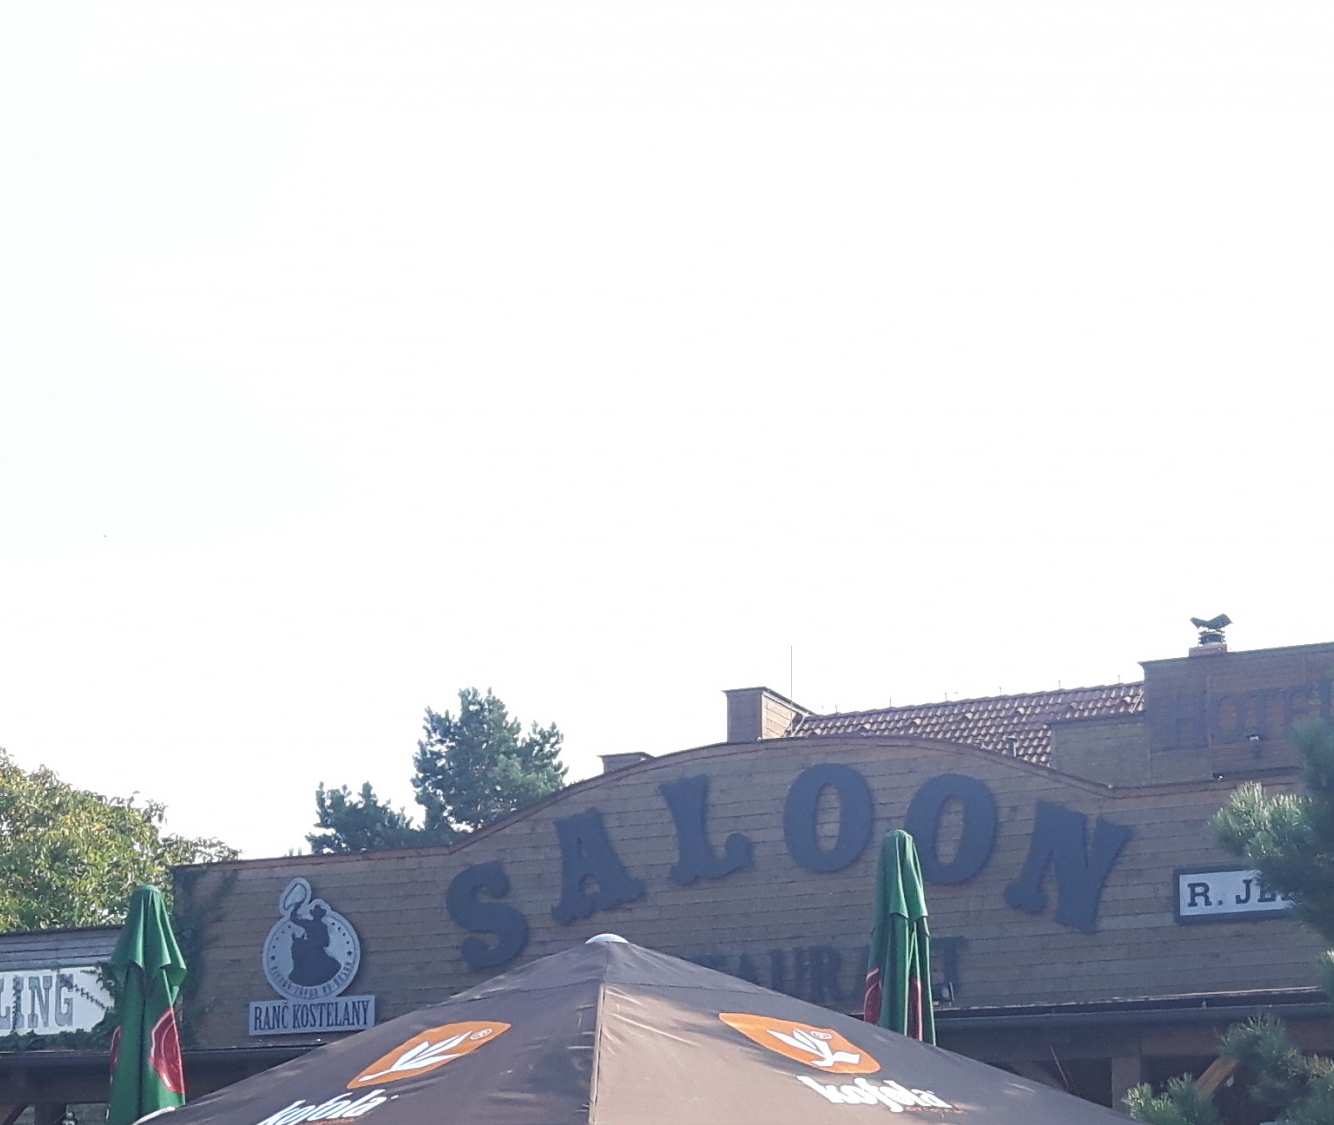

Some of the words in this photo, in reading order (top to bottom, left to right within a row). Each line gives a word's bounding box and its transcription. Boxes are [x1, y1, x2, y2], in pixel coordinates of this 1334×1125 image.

[445, 762, 1134, 970] SALOON
[254, 1001, 290, 1031] RANČ
[292, 1000, 370, 1030] KOSTELANY
